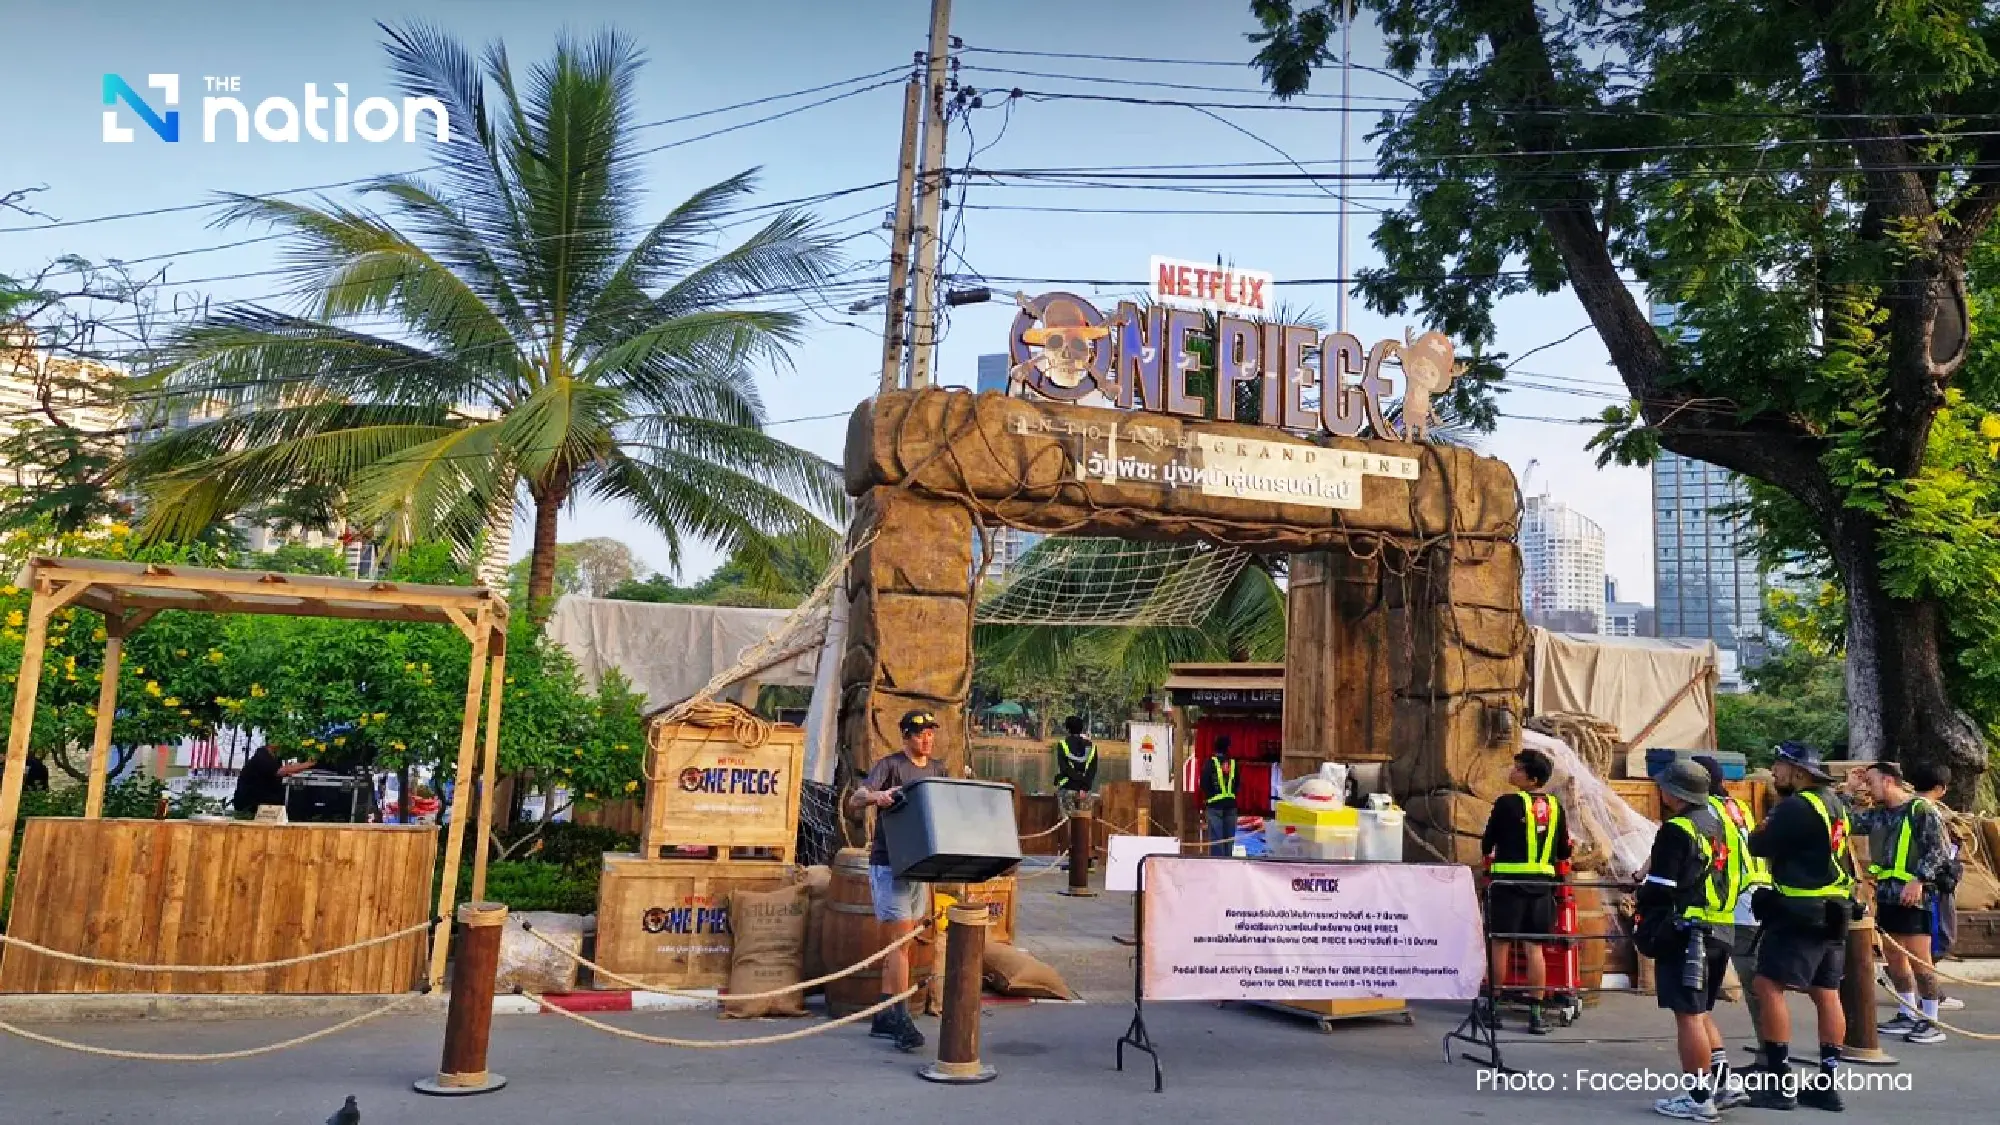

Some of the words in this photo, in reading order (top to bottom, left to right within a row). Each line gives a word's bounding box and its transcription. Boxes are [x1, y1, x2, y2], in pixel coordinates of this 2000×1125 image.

[1157, 262, 1264, 310] NETFLIX
[1008, 290, 1206, 418] ONE
[1216, 315, 1406, 442] PIECE
[1213, 440, 1318, 466] GRAND
[1342, 456, 1414, 475] LINE
[730, 768, 781, 796] PIECE
[1354, 924, 1372, 933] ONE
[1302, 936, 1319, 944] ONE
[1321, 936, 1346, 945] PIECE
[1172, 965, 1197, 974] Pedal
[1198, 966, 1218, 974] Boat
[1220, 965, 1252, 976] Activity
[1254, 966, 1284, 975] Closed
[1302, 966, 1326, 975] March
[1328, 966, 1340, 974] for
[1342, 966, 1361, 975] ONE
[1363, 966, 1387, 975] PIECE
[1389, 966, 1411, 975] Event
[1412, 966, 1459, 976] Preparation
[1239, 979, 1263, 988] Open
[1264, 979, 1275, 987] for
[1297, 979, 1322, 987] PIECE
[1325, 979, 1348, 987] Event
[1373, 979, 1397, 987] March
